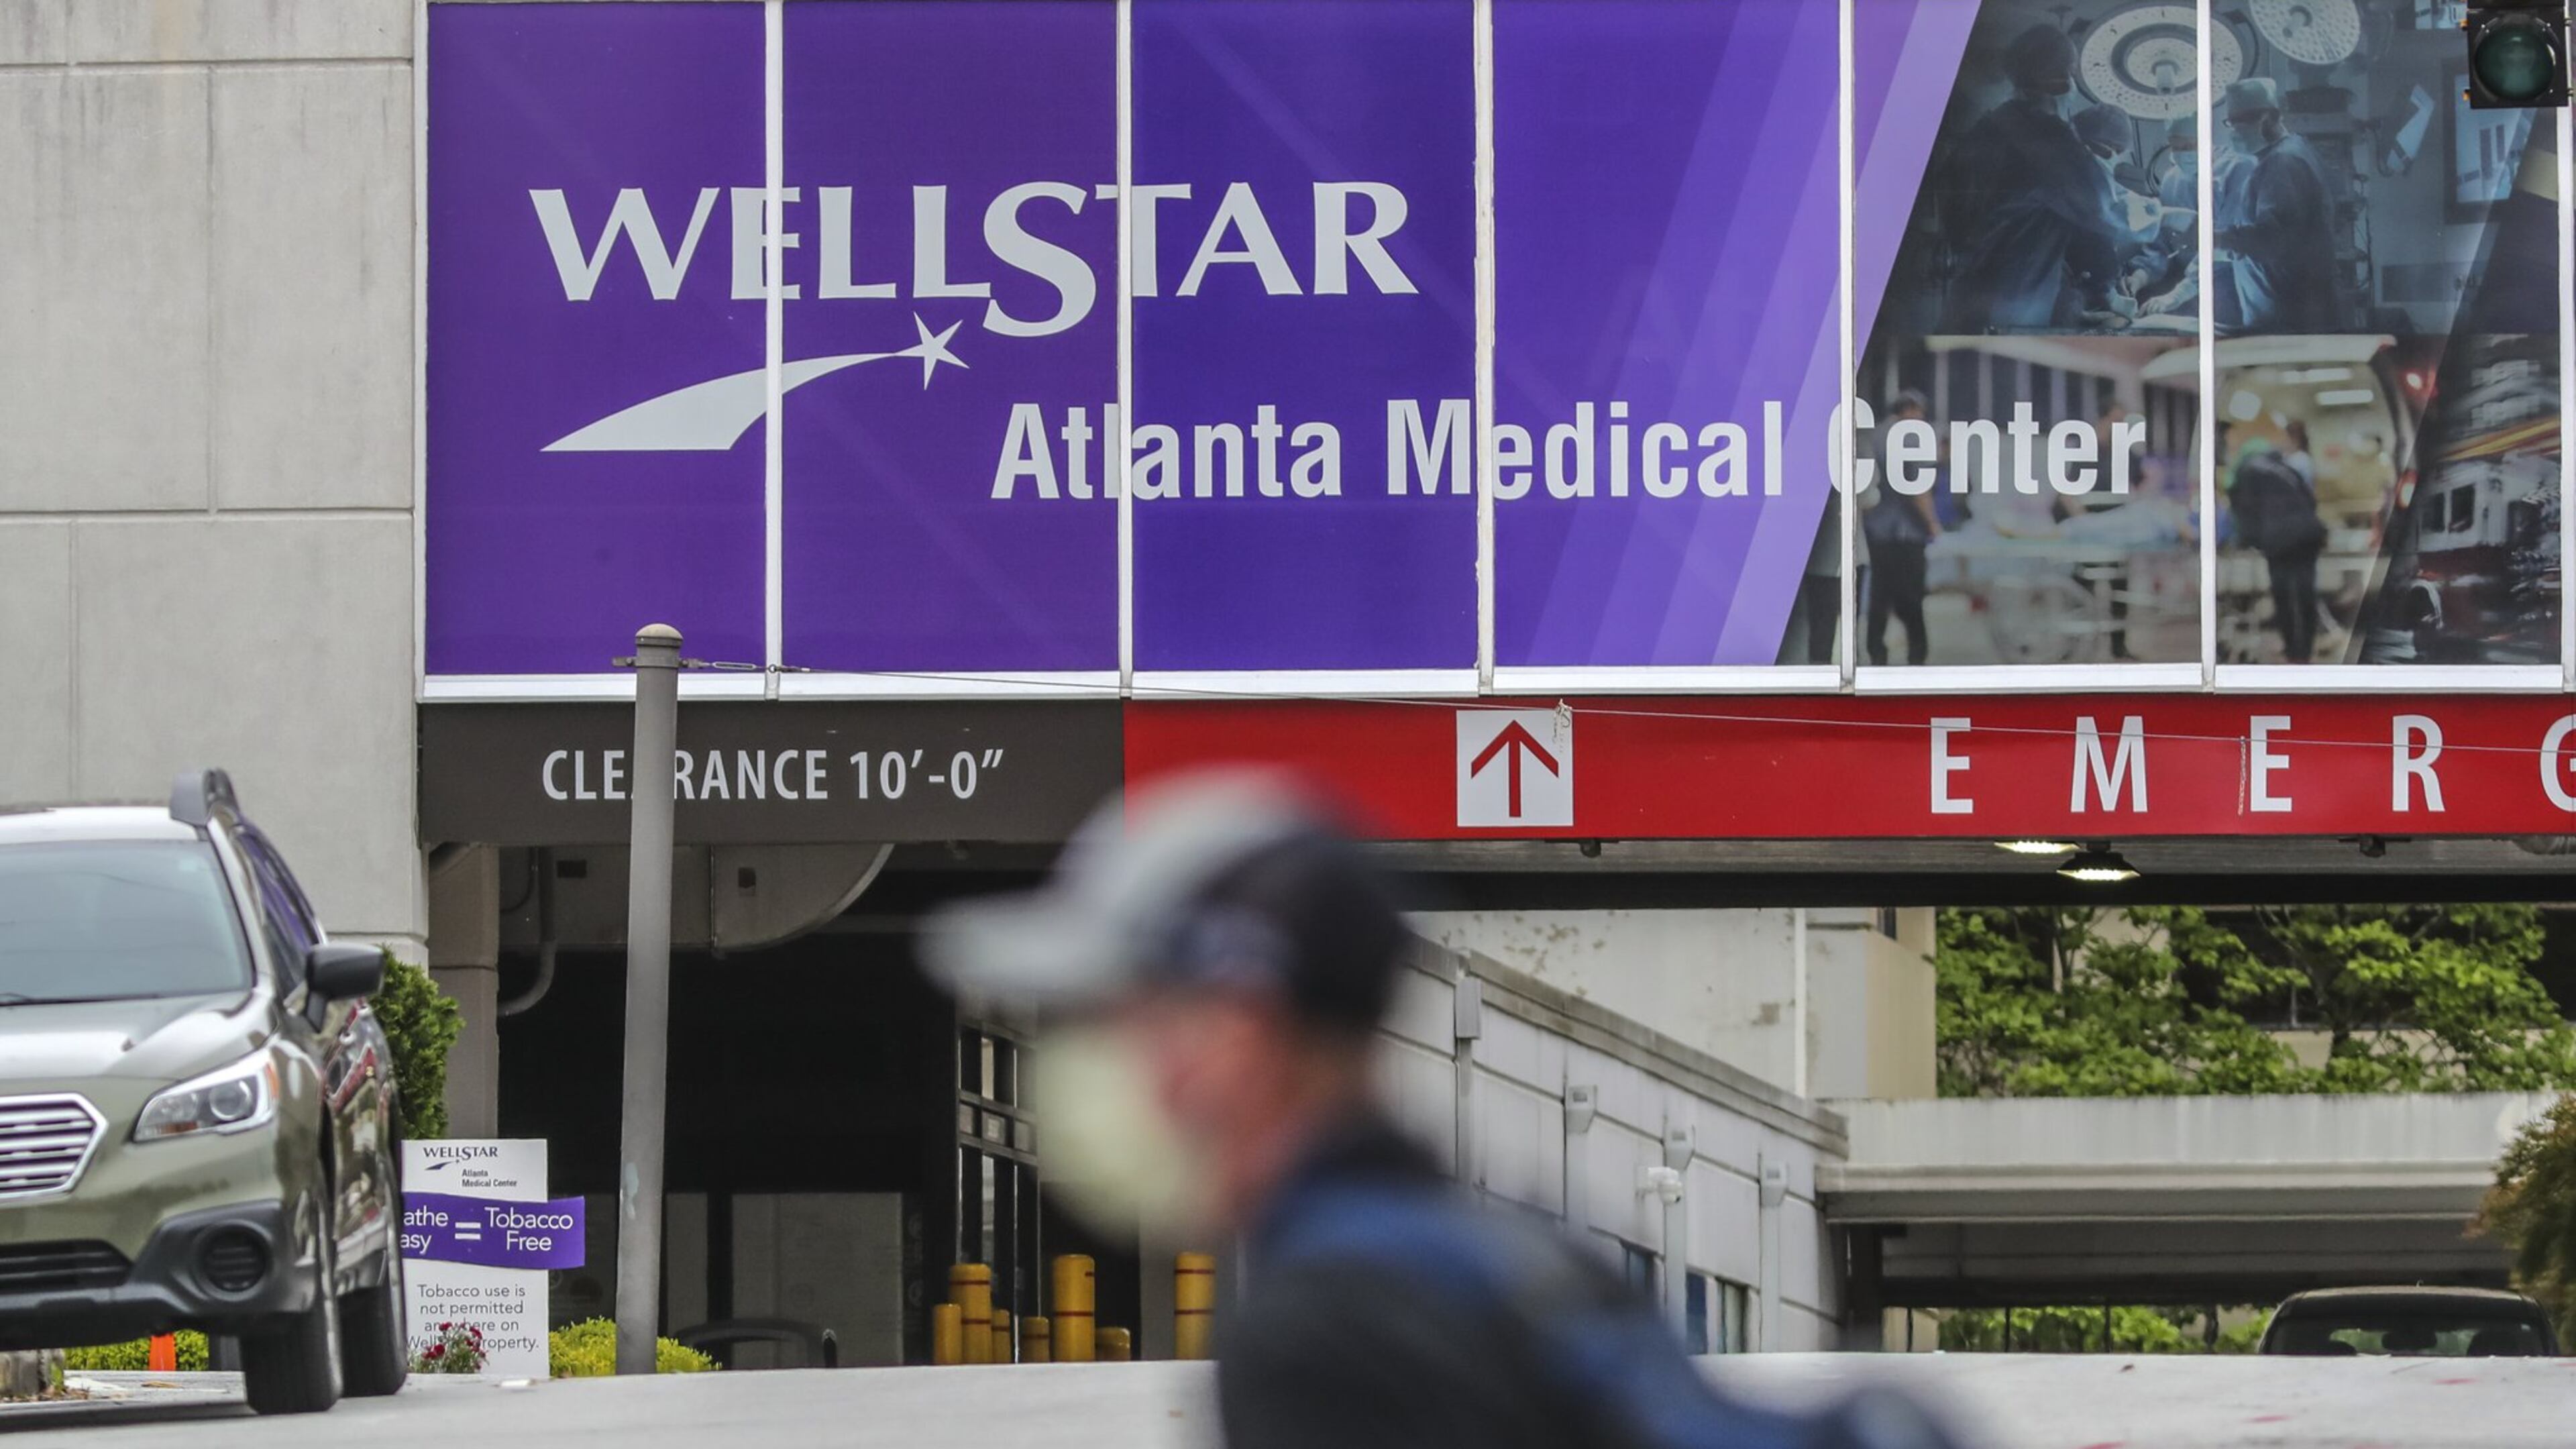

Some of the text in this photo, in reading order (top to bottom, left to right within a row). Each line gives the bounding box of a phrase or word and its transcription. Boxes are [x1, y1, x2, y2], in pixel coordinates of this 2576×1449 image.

[528, 181, 1419, 337] WELLSTAR
[990, 396, 2147, 500] Atlanta Medical Center
[542, 749, 828, 800] CLERANCE
[423, 1146, 498, 1161] WELLSTAR
[462, 1169, 489, 1177] Atlanta
[462, 1179, 518, 1187] Medical Center
[403, 1205, 449, 1227] athe
[484, 1207, 574, 1230] Tobacco
[400, 1230, 552, 1255] asy Free
[417, 1284, 526, 1298] Tobacco use is
[420, 1300, 524, 1318] not permitted
[500, 1321, 519, 1332] on
[477, 1336, 539, 1352] roperty.
